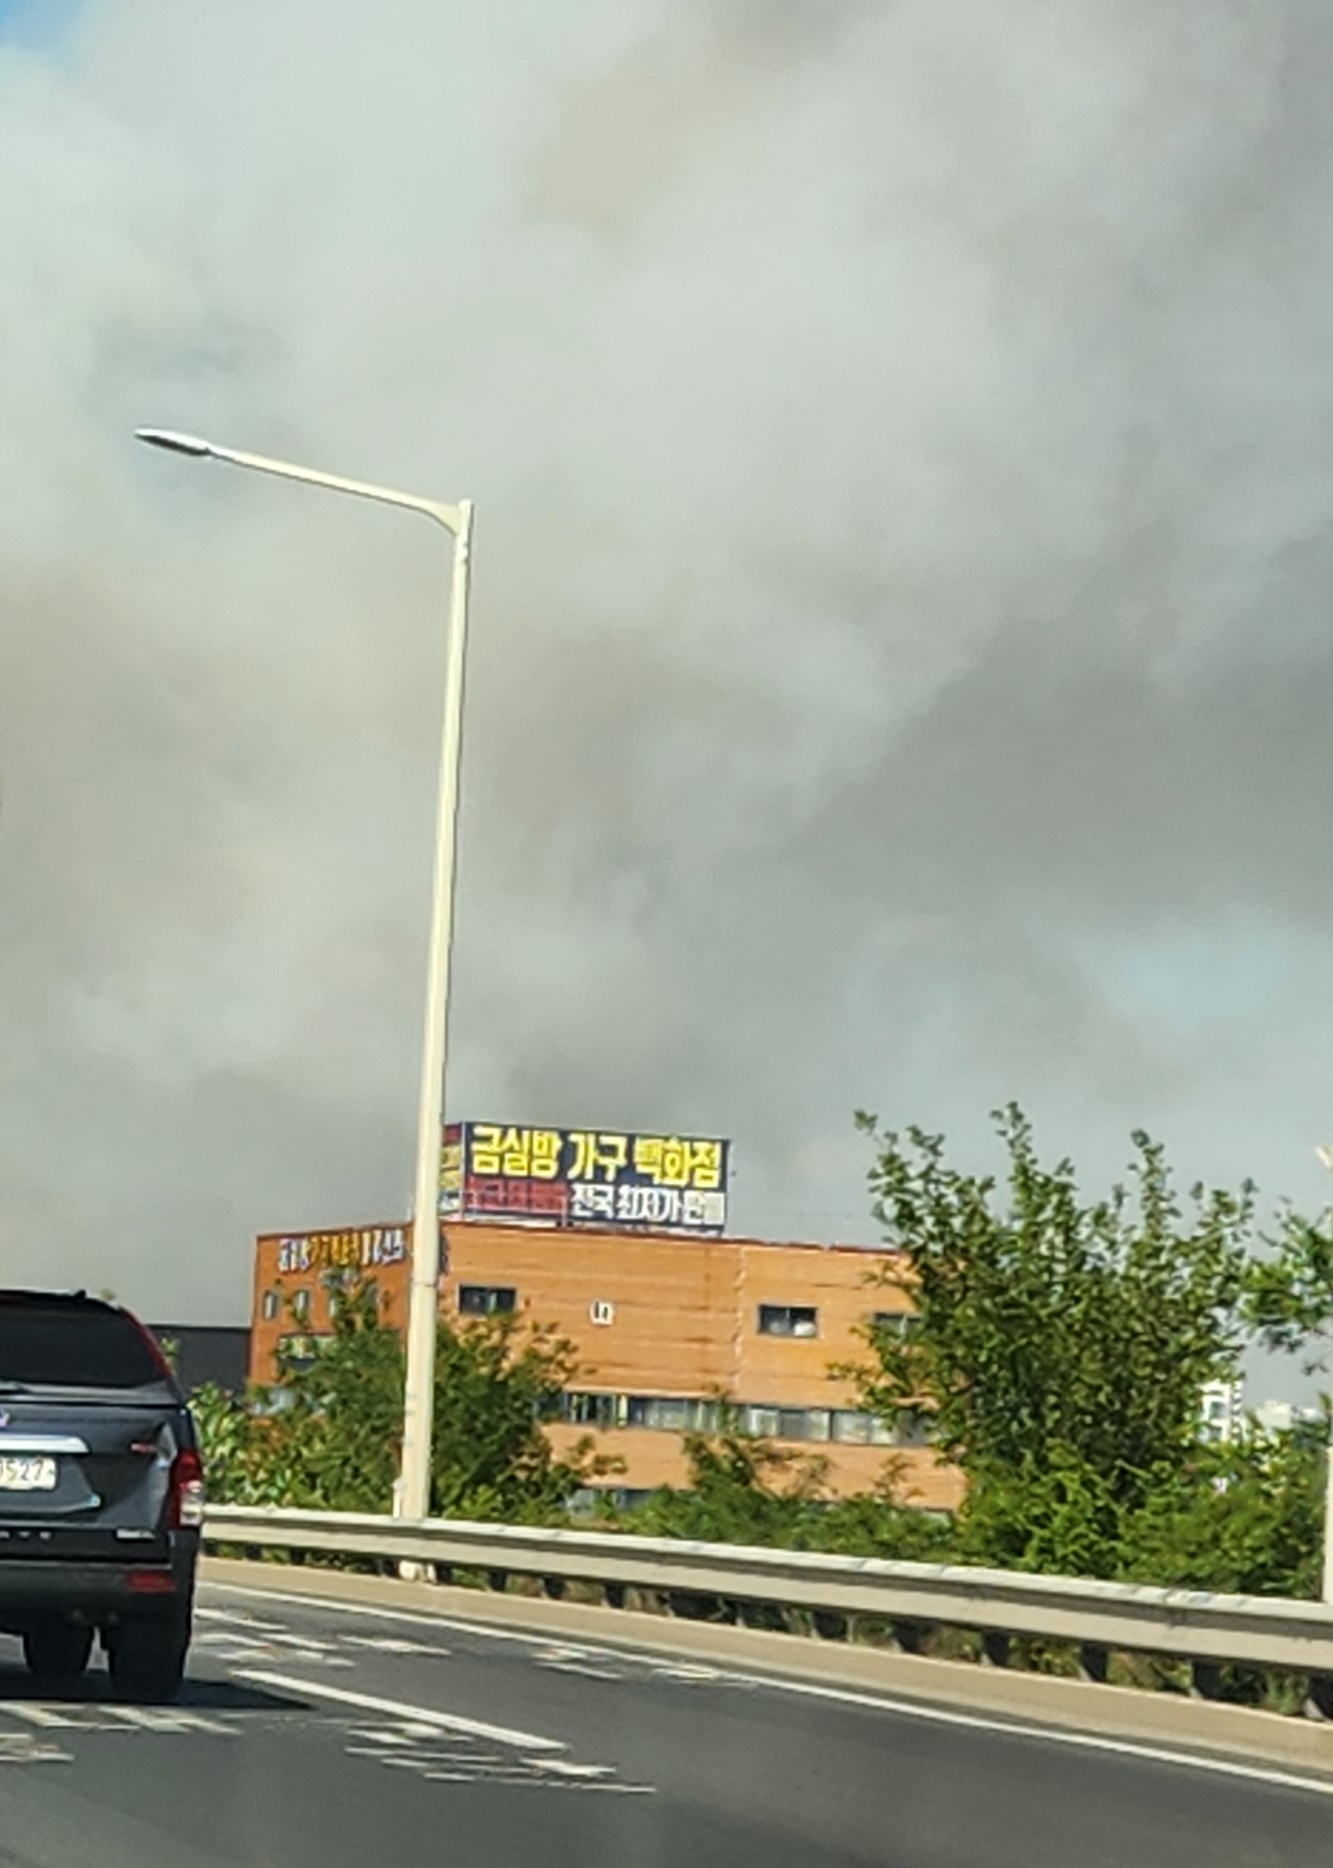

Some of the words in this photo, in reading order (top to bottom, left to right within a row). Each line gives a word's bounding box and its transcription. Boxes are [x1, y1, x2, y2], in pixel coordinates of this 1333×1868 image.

[471, 1125, 563, 1178] 금실방
[566, 1132, 628, 1181] 가구
[634, 1134, 722, 1188] 백화점
[570, 1183, 614, 1219] 전국
